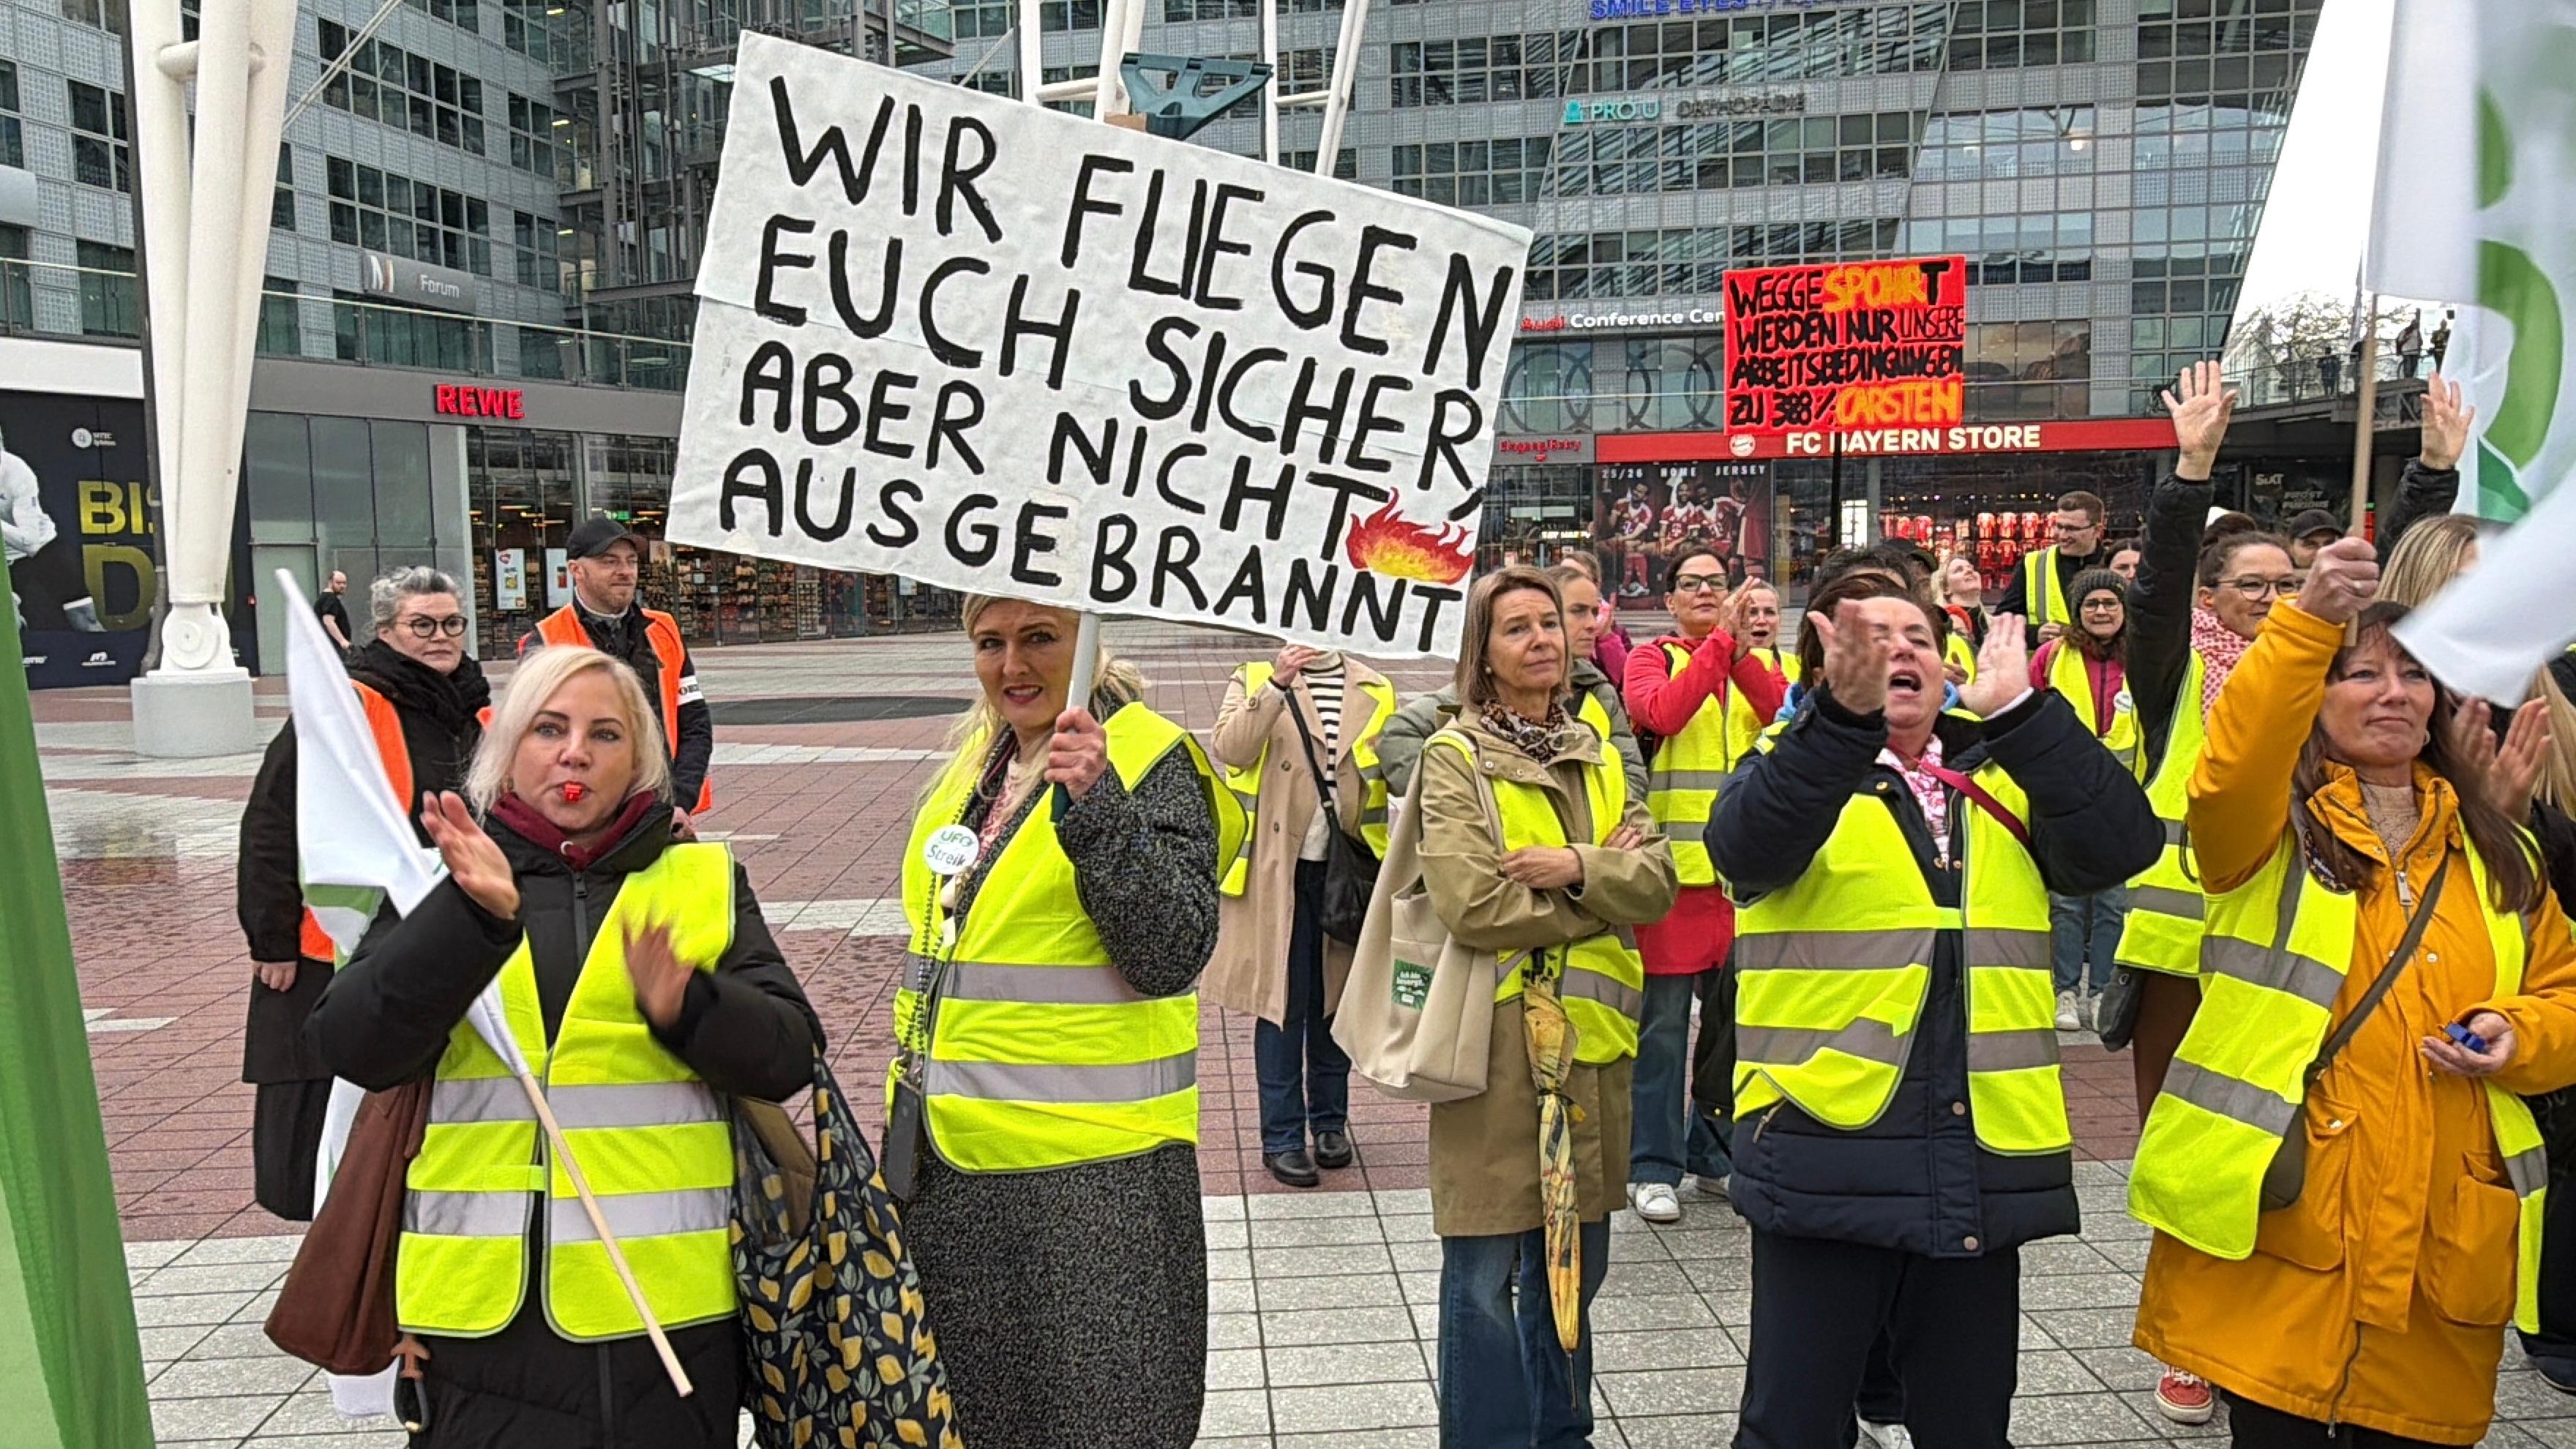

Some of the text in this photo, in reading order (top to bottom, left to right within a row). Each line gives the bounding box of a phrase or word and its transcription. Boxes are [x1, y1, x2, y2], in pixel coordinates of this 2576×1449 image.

[1591, 0, 1669, 19] SMILE
[770, 75, 1513, 390] WIR FLIEGEN
[419, 274, 460, 299] Forum
[1570, 311, 1683, 328] Conference
[1734, 304, 1964, 355] WERDEN NUR UNSERE
[755, 214, 1486, 520] EUCH SICHER,
[435, 383, 525, 419] REWE
[1729, 393, 1764, 426] ZU
[1835, 381, 1961, 427] CARSTEN
[739, 340, 1390, 561] ABER NICHT
[1786, 432, 1821, 454] FC
[1947, 424, 2041, 450] STORE
[1602, 465, 1766, 479] 25/26 HOME JERSEY
[719, 447, 1462, 652] AUSGEBRANNT
[940, 830, 975, 847] UFO
[927, 845, 966, 866] Streik
